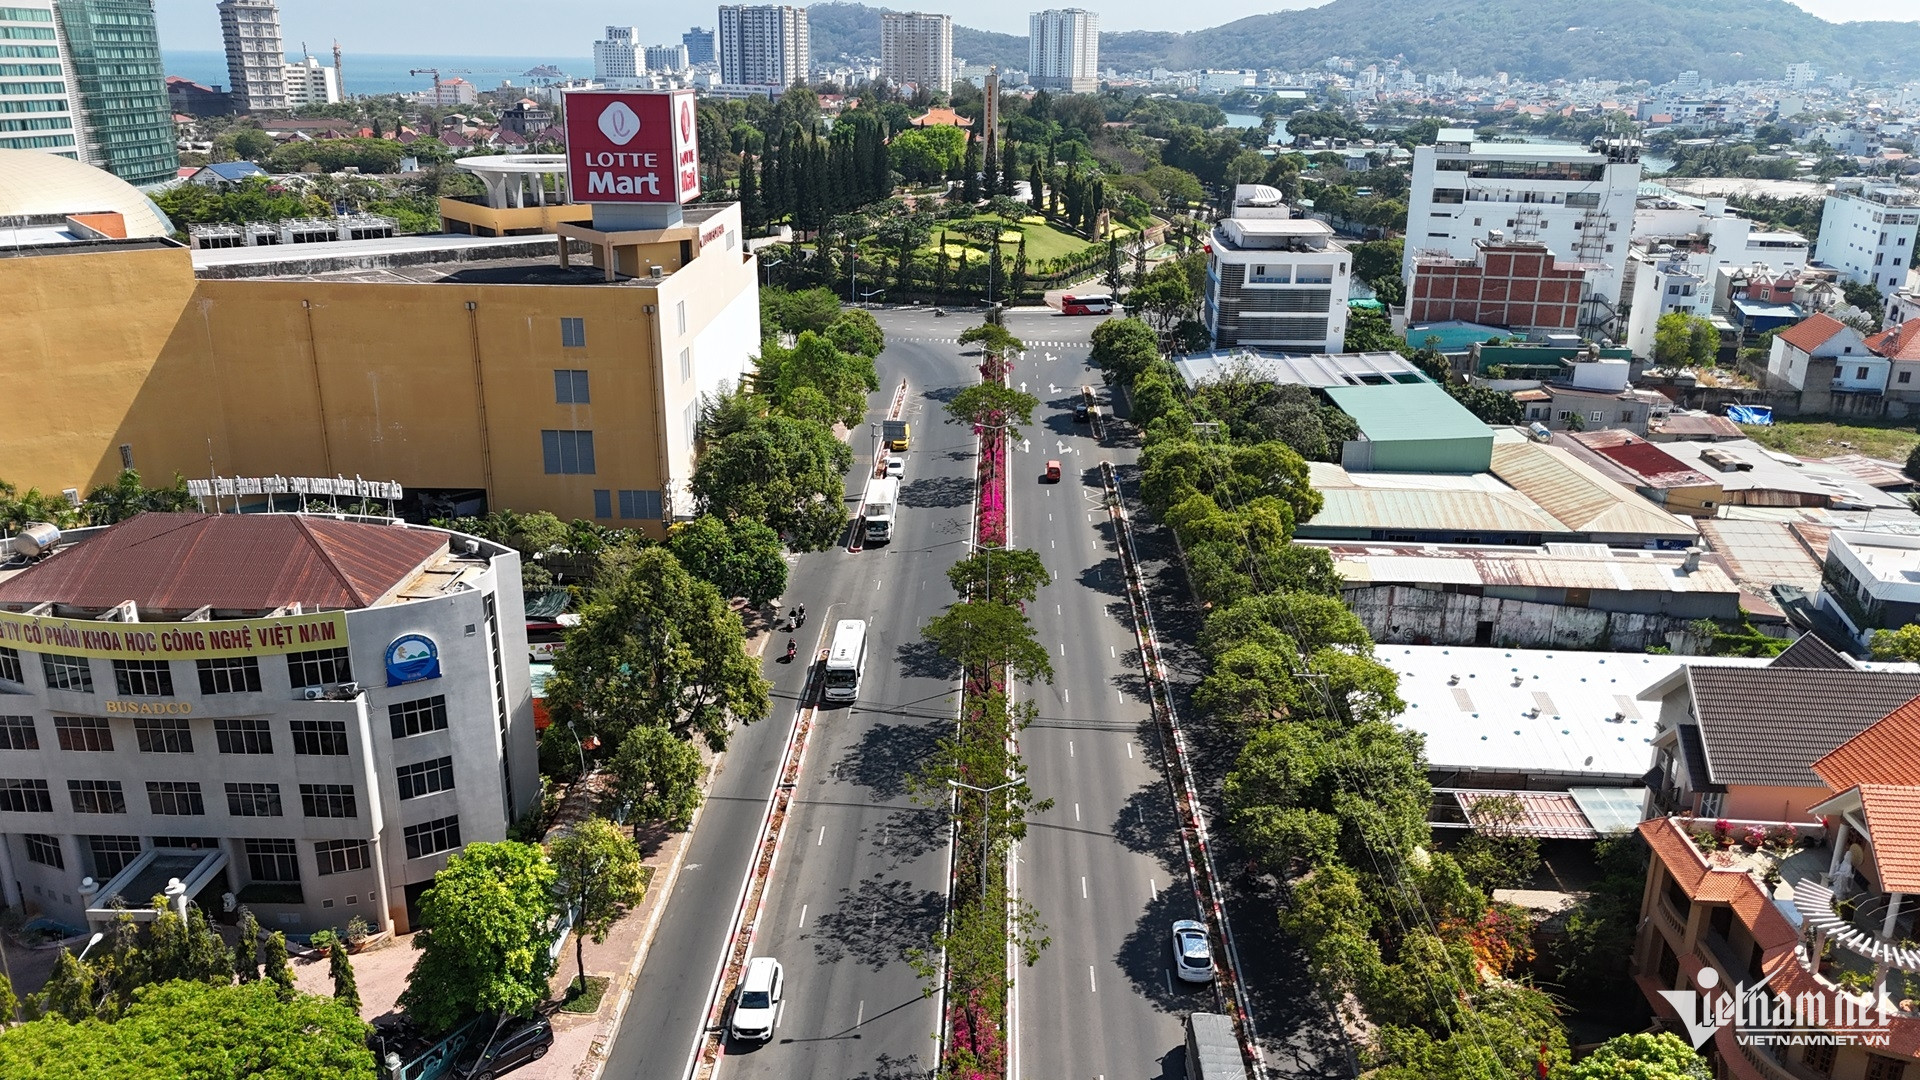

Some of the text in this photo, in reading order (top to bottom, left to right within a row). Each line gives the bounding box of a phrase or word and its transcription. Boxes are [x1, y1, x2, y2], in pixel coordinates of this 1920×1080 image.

[585, 152, 658, 167] LOTTE
[588, 171, 660, 195] Mart
[4, 620, 21, 642] TY
[23, 617, 43, 644] CỔ
[45, 621, 80, 648] PHẦN
[82, 630, 123, 651] KHOA
[125, 632, 157, 656] HỌC
[161, 628, 206, 651] CÔNG
[208, 624, 253, 651] NGHỆ
[256, 621, 293, 649] VIỆT
[298, 621, 336, 643] NAM
[105, 700, 192, 714] BUSADCO
